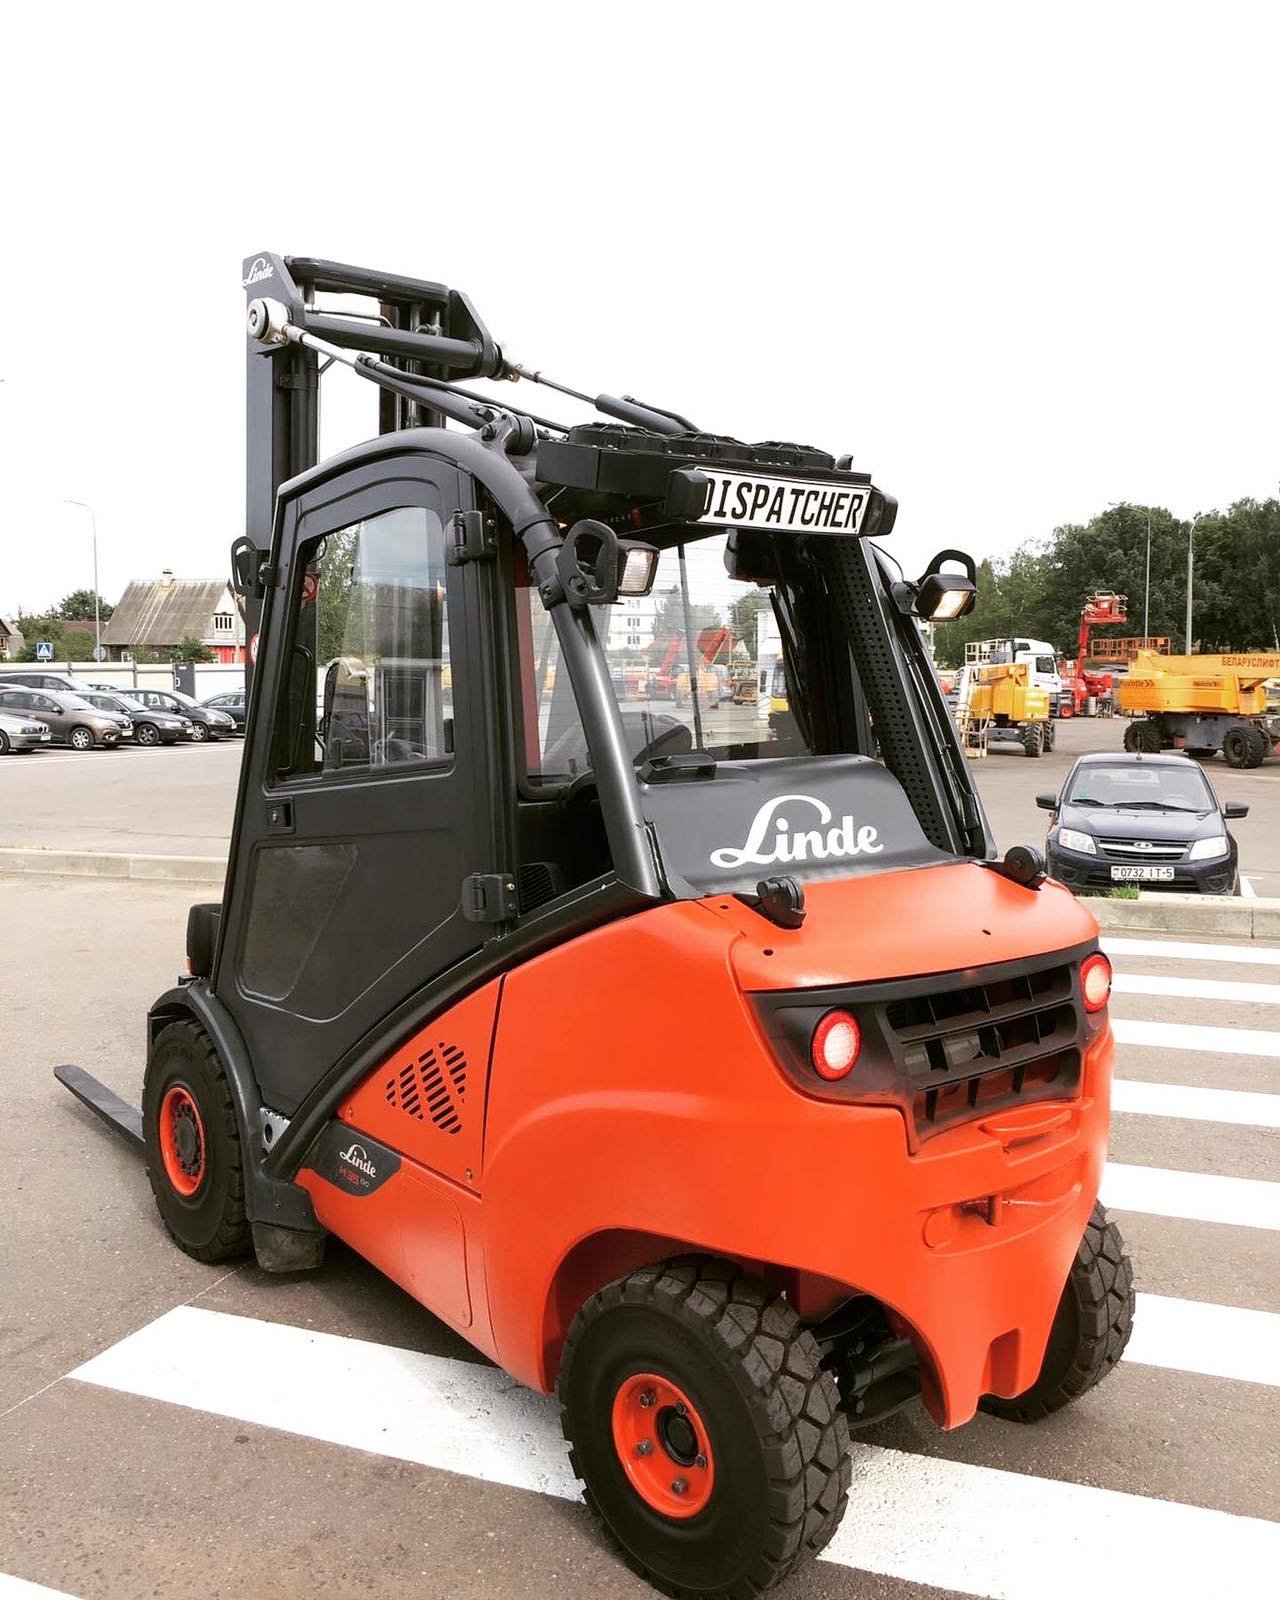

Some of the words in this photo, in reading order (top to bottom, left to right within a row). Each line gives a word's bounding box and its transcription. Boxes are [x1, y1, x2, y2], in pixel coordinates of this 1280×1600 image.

[242, 257, 274, 287] Linde
[703, 477, 864, 529] DISPATCHER
[1221, 656, 1280, 669] БЕЛАРУСЛИФТ
[709, 794, 884, 869] Linde
[1120, 867, 1145, 878] 0732
[1150, 868, 1173, 878] IT-5
[339, 1144, 376, 1178] Linde
